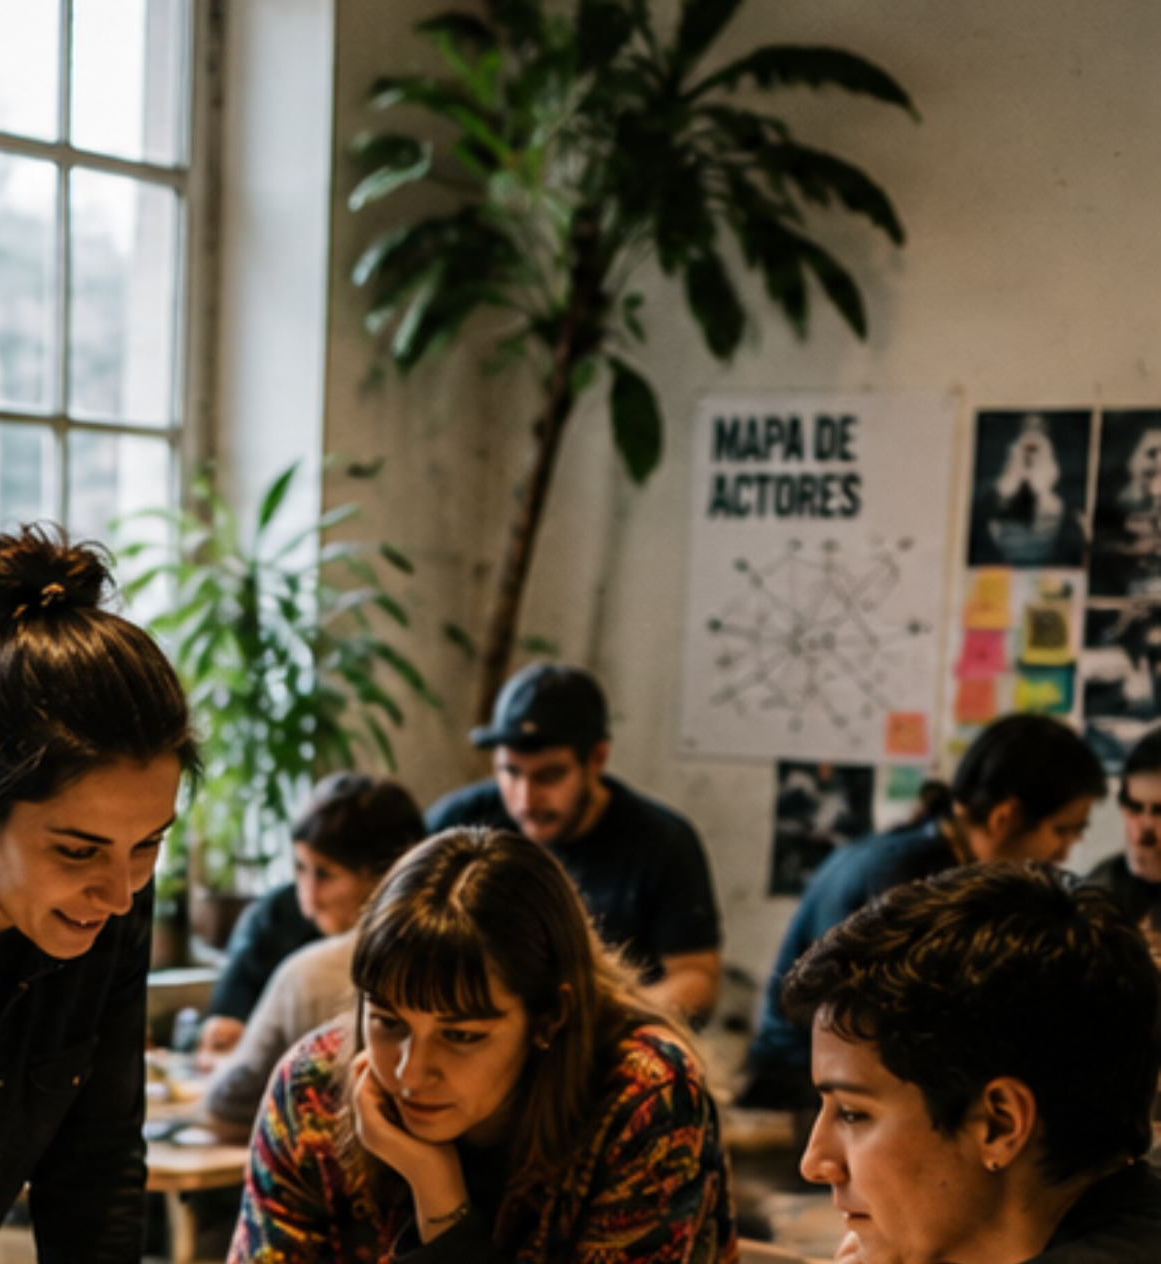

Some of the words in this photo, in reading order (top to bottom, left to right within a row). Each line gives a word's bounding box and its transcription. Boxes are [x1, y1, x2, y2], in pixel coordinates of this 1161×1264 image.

[712, 415, 805, 463] MAPA
[813, 415, 857, 463] DE
[708, 471, 862, 520] ACTORES
